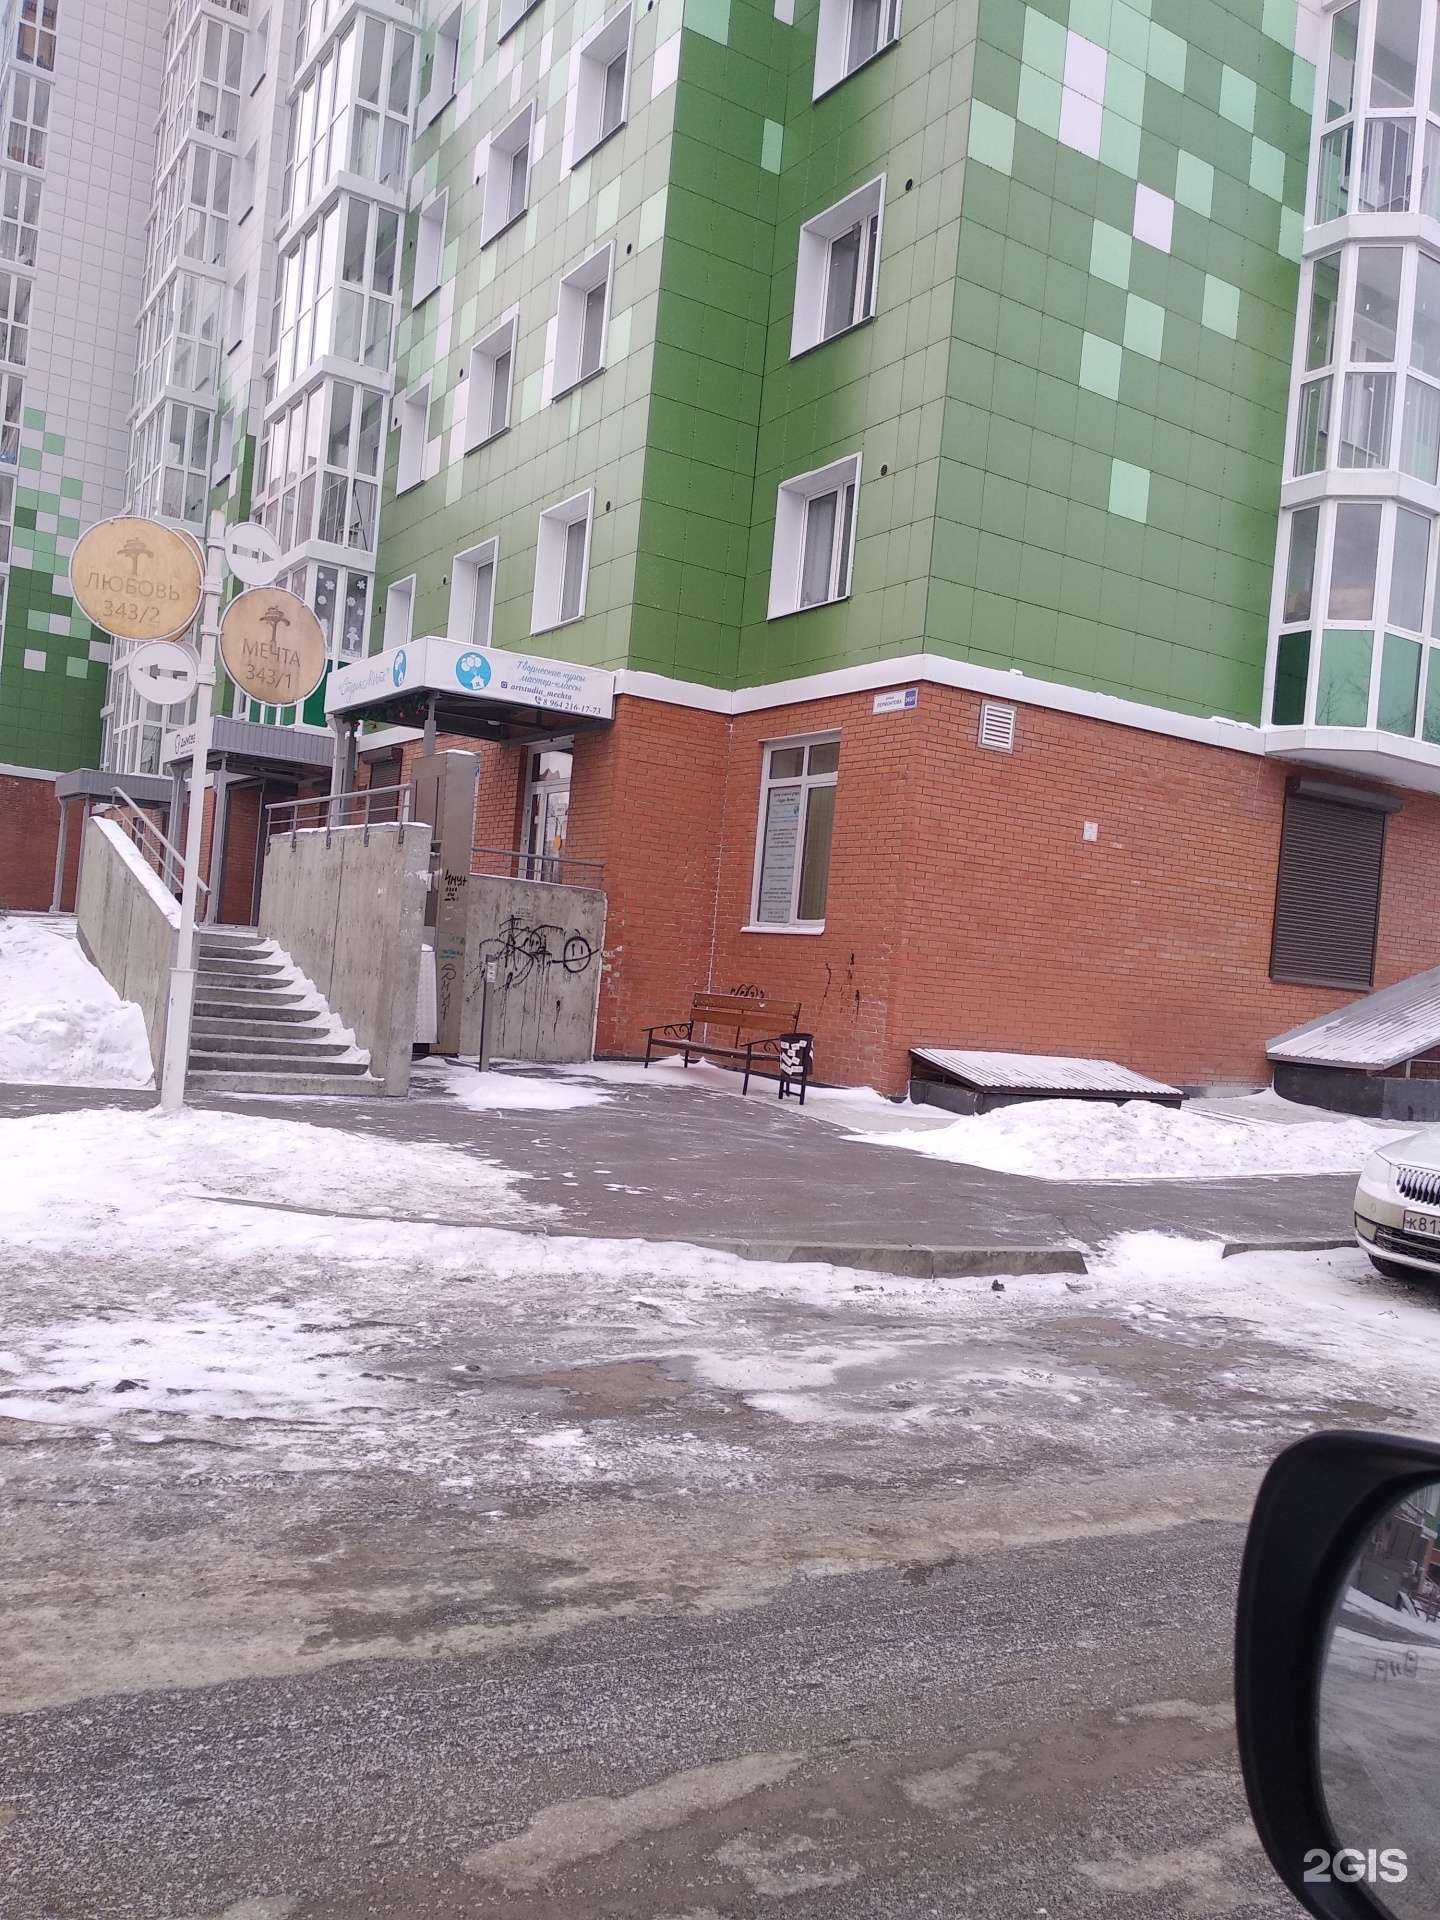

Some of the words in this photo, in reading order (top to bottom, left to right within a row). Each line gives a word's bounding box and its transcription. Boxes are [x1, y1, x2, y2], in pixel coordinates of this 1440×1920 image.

[85, 572, 180, 601] ЛЮБОВЬ
[103, 600, 160, 624] 343/2
[243, 638, 300, 668] МЕЧТА
[246, 663, 292, 689] 343/1
